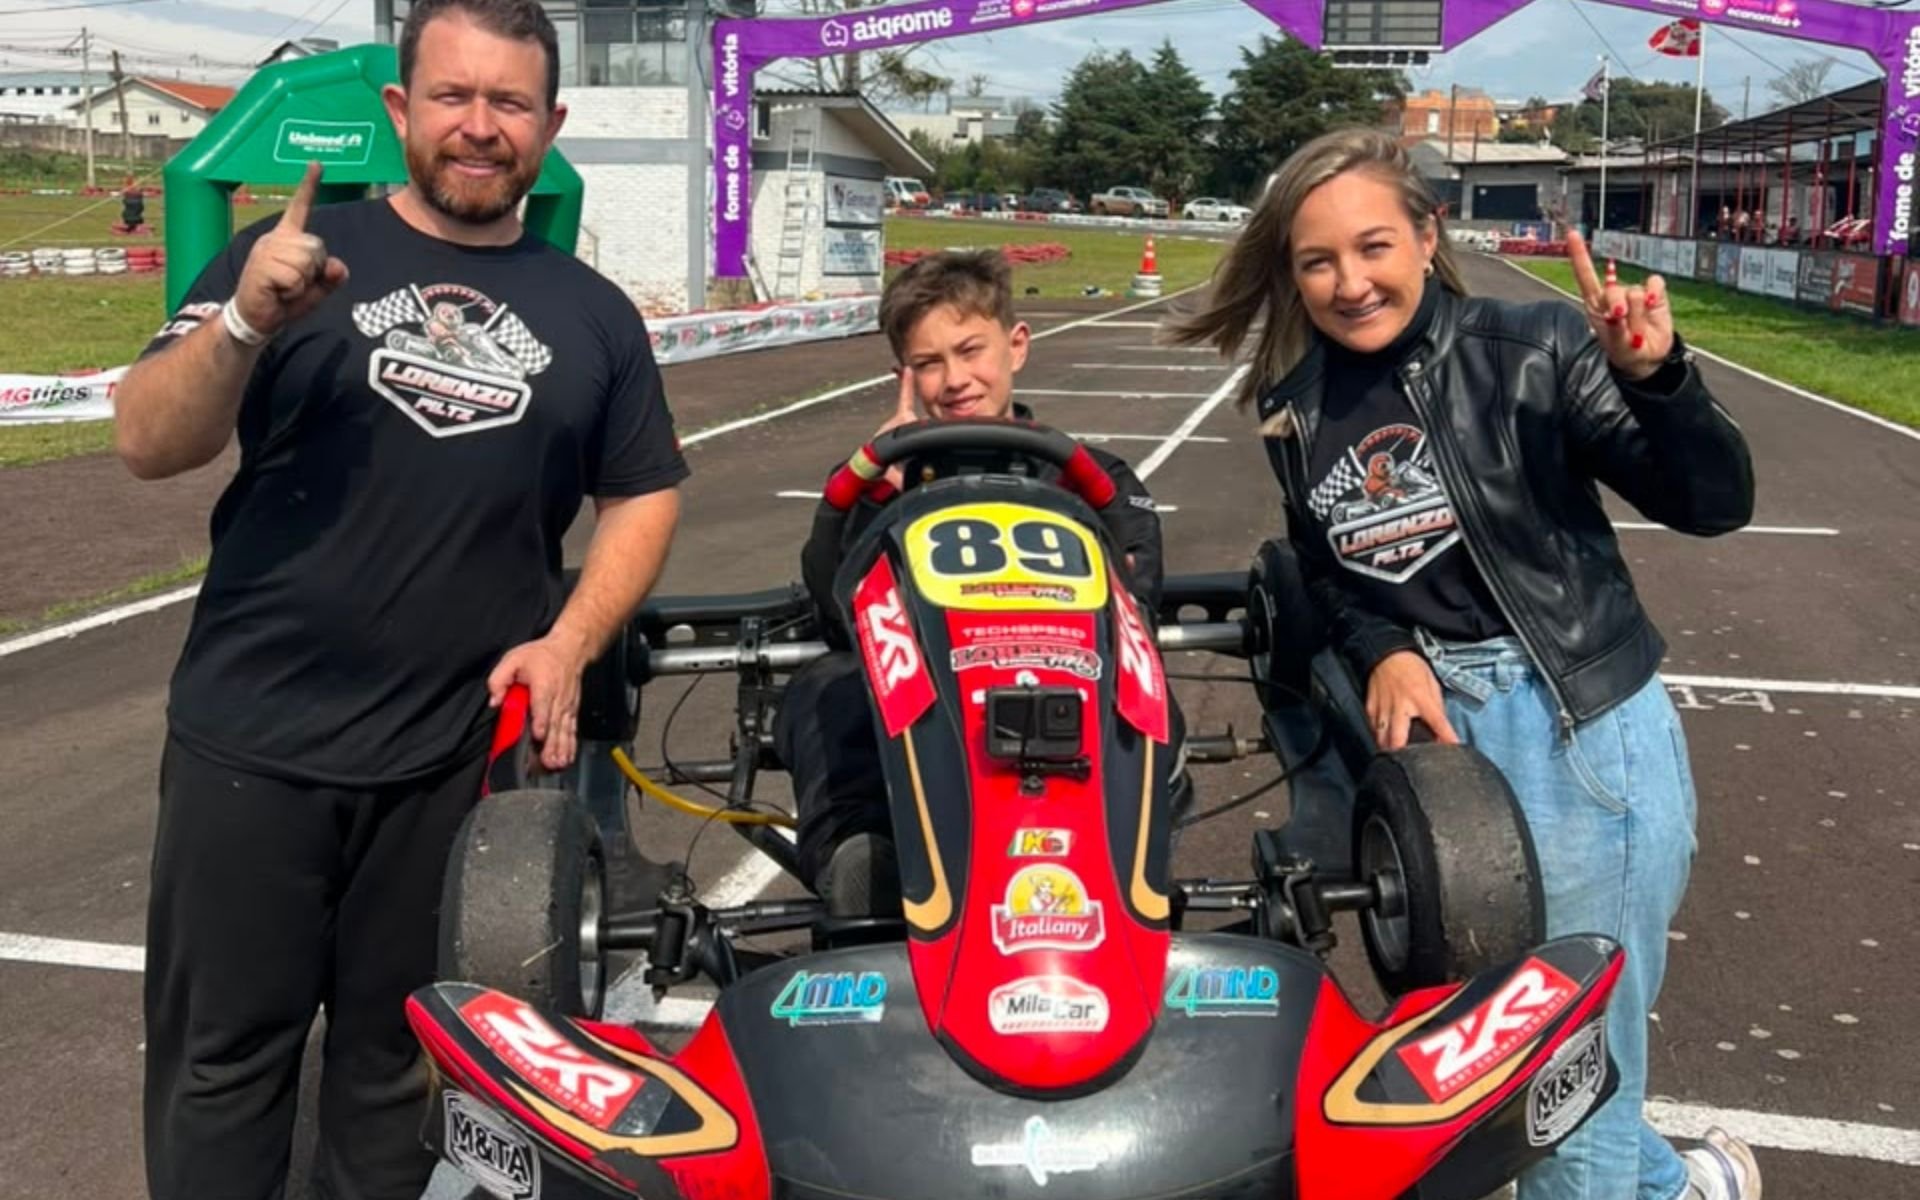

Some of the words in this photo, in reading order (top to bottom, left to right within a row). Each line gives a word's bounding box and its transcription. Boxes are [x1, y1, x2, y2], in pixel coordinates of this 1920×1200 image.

[853, 7, 952, 41] aiqfome
[722, 33, 739, 97] vitória
[723, 145, 740, 169] de
[1894, 153, 1916, 181] de
[723, 172, 740, 221] fome
[1889, 184, 1913, 241] fome
[381, 361, 520, 410] LORENZO
[414, 396, 477, 423] PILTZ
[928, 519, 1093, 577] 89
[1341, 506, 1454, 556] LORENZO
[1373, 540, 1426, 567] PILTZ
[961, 624, 1088, 640] TECHSPEED
[1009, 917, 1089, 939] Italiany
[1535, 1026, 1603, 1121] M&TA
[451, 1108, 531, 1185] M&TA
